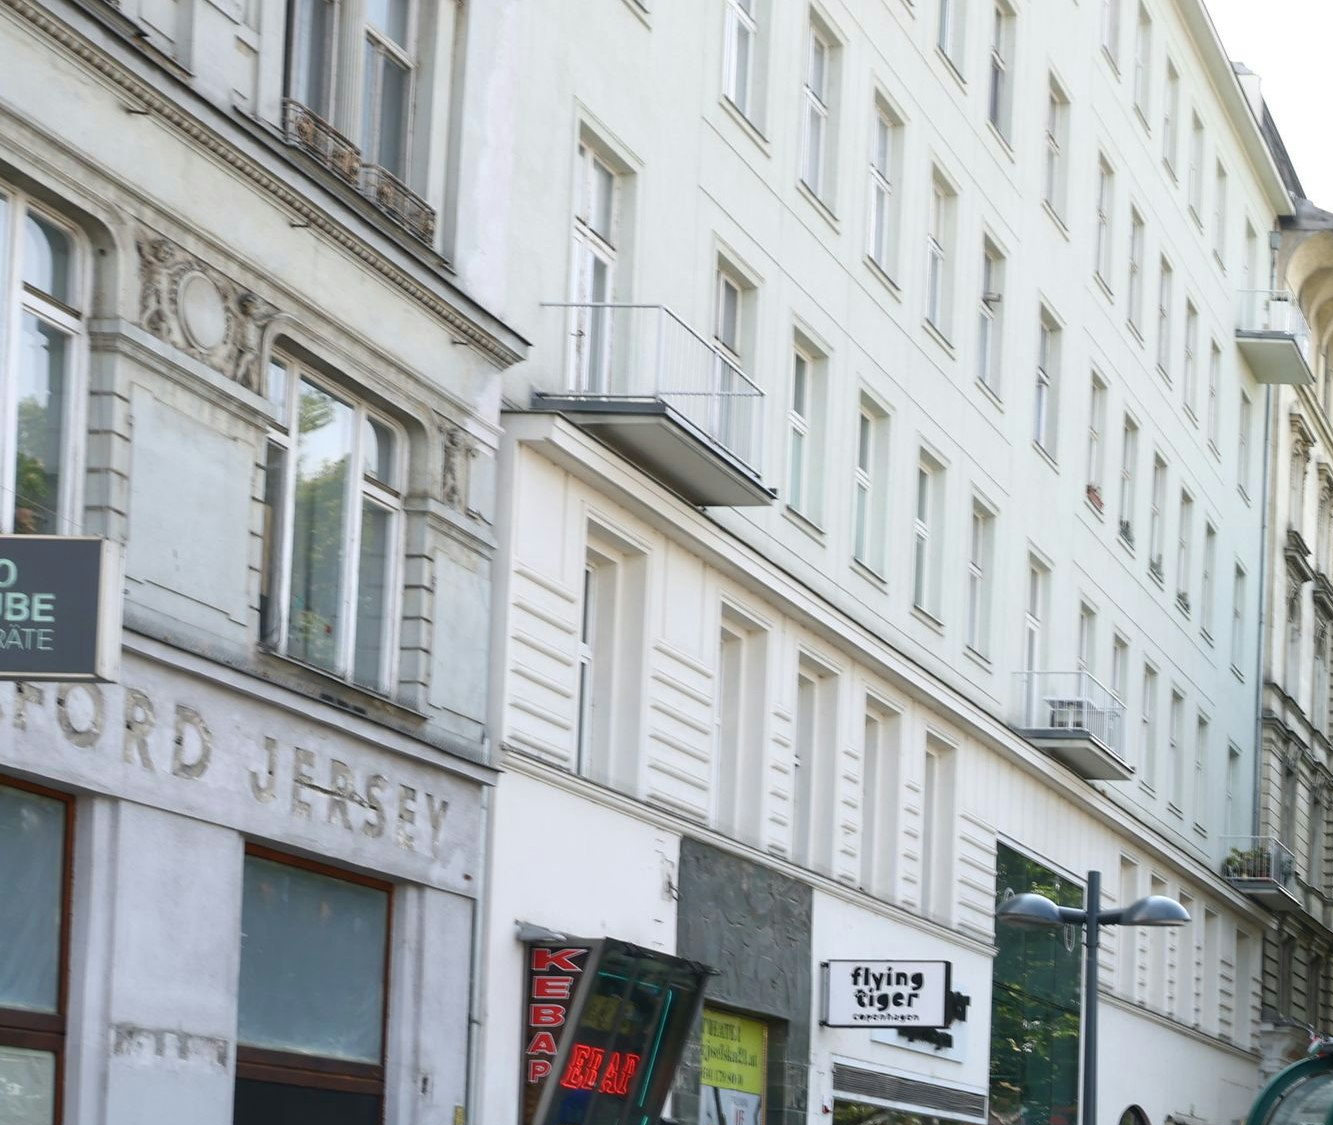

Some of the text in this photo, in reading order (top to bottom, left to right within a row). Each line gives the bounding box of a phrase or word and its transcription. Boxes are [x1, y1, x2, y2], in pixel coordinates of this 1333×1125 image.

[0, 681, 449, 866] FORD JERSEY
[851, 967, 924, 991] flying
[855, 988, 919, 1011] tiger
[525, 948, 589, 1083] KEBAP
[852, 1013, 919, 1023] copenhagen
